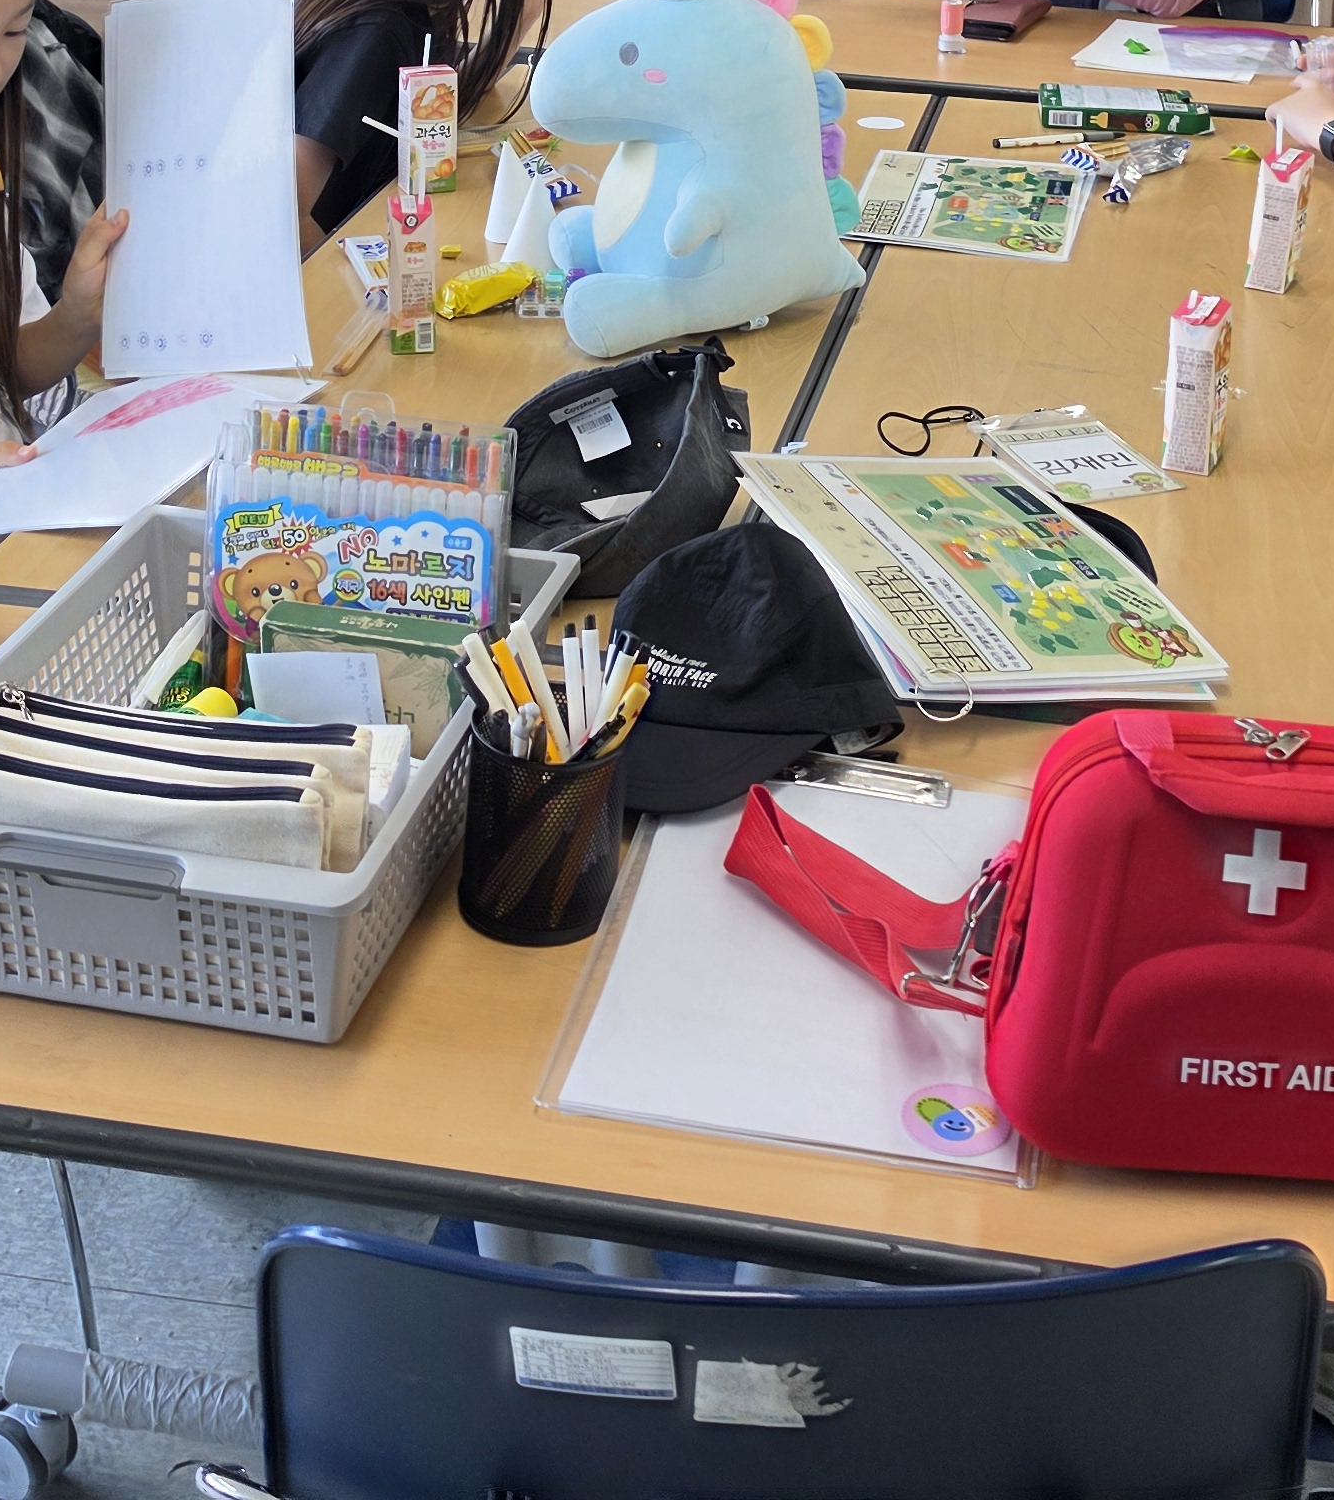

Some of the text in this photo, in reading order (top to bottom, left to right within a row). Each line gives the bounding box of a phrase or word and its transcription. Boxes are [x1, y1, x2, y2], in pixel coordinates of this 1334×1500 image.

[415, 123, 451, 139] 과수원
[1033, 452, 1138, 476] 김재민
[239, 513, 269, 526] NEW
[338, 526, 379, 564] NO
[363, 548, 475, 582] 노마르지
[368, 578, 471, 611] 16색 사인펜
[684, 668, 717, 682] FACE
[1179, 1056, 1280, 1092] FIRST
